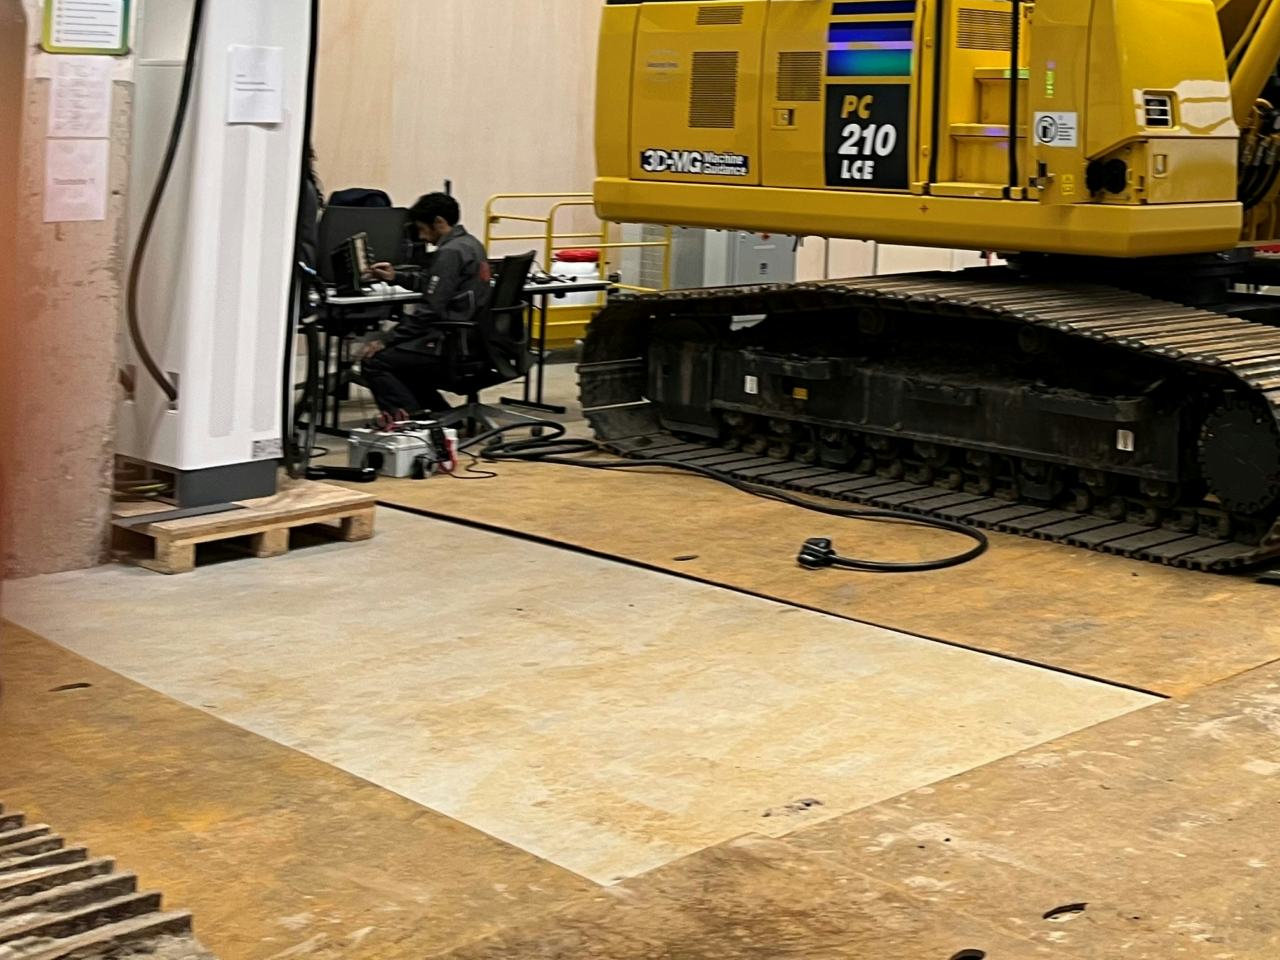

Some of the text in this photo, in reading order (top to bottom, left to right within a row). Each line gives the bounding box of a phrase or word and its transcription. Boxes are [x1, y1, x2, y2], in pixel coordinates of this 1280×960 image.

[841, 94, 874, 119] PC
[837, 123, 897, 157] 210
[642, 149, 702, 174] 3D-MG
[702, 151, 744, 165] Machine
[702, 162, 747, 176] Guidance
[840, 159, 875, 180] LCE
